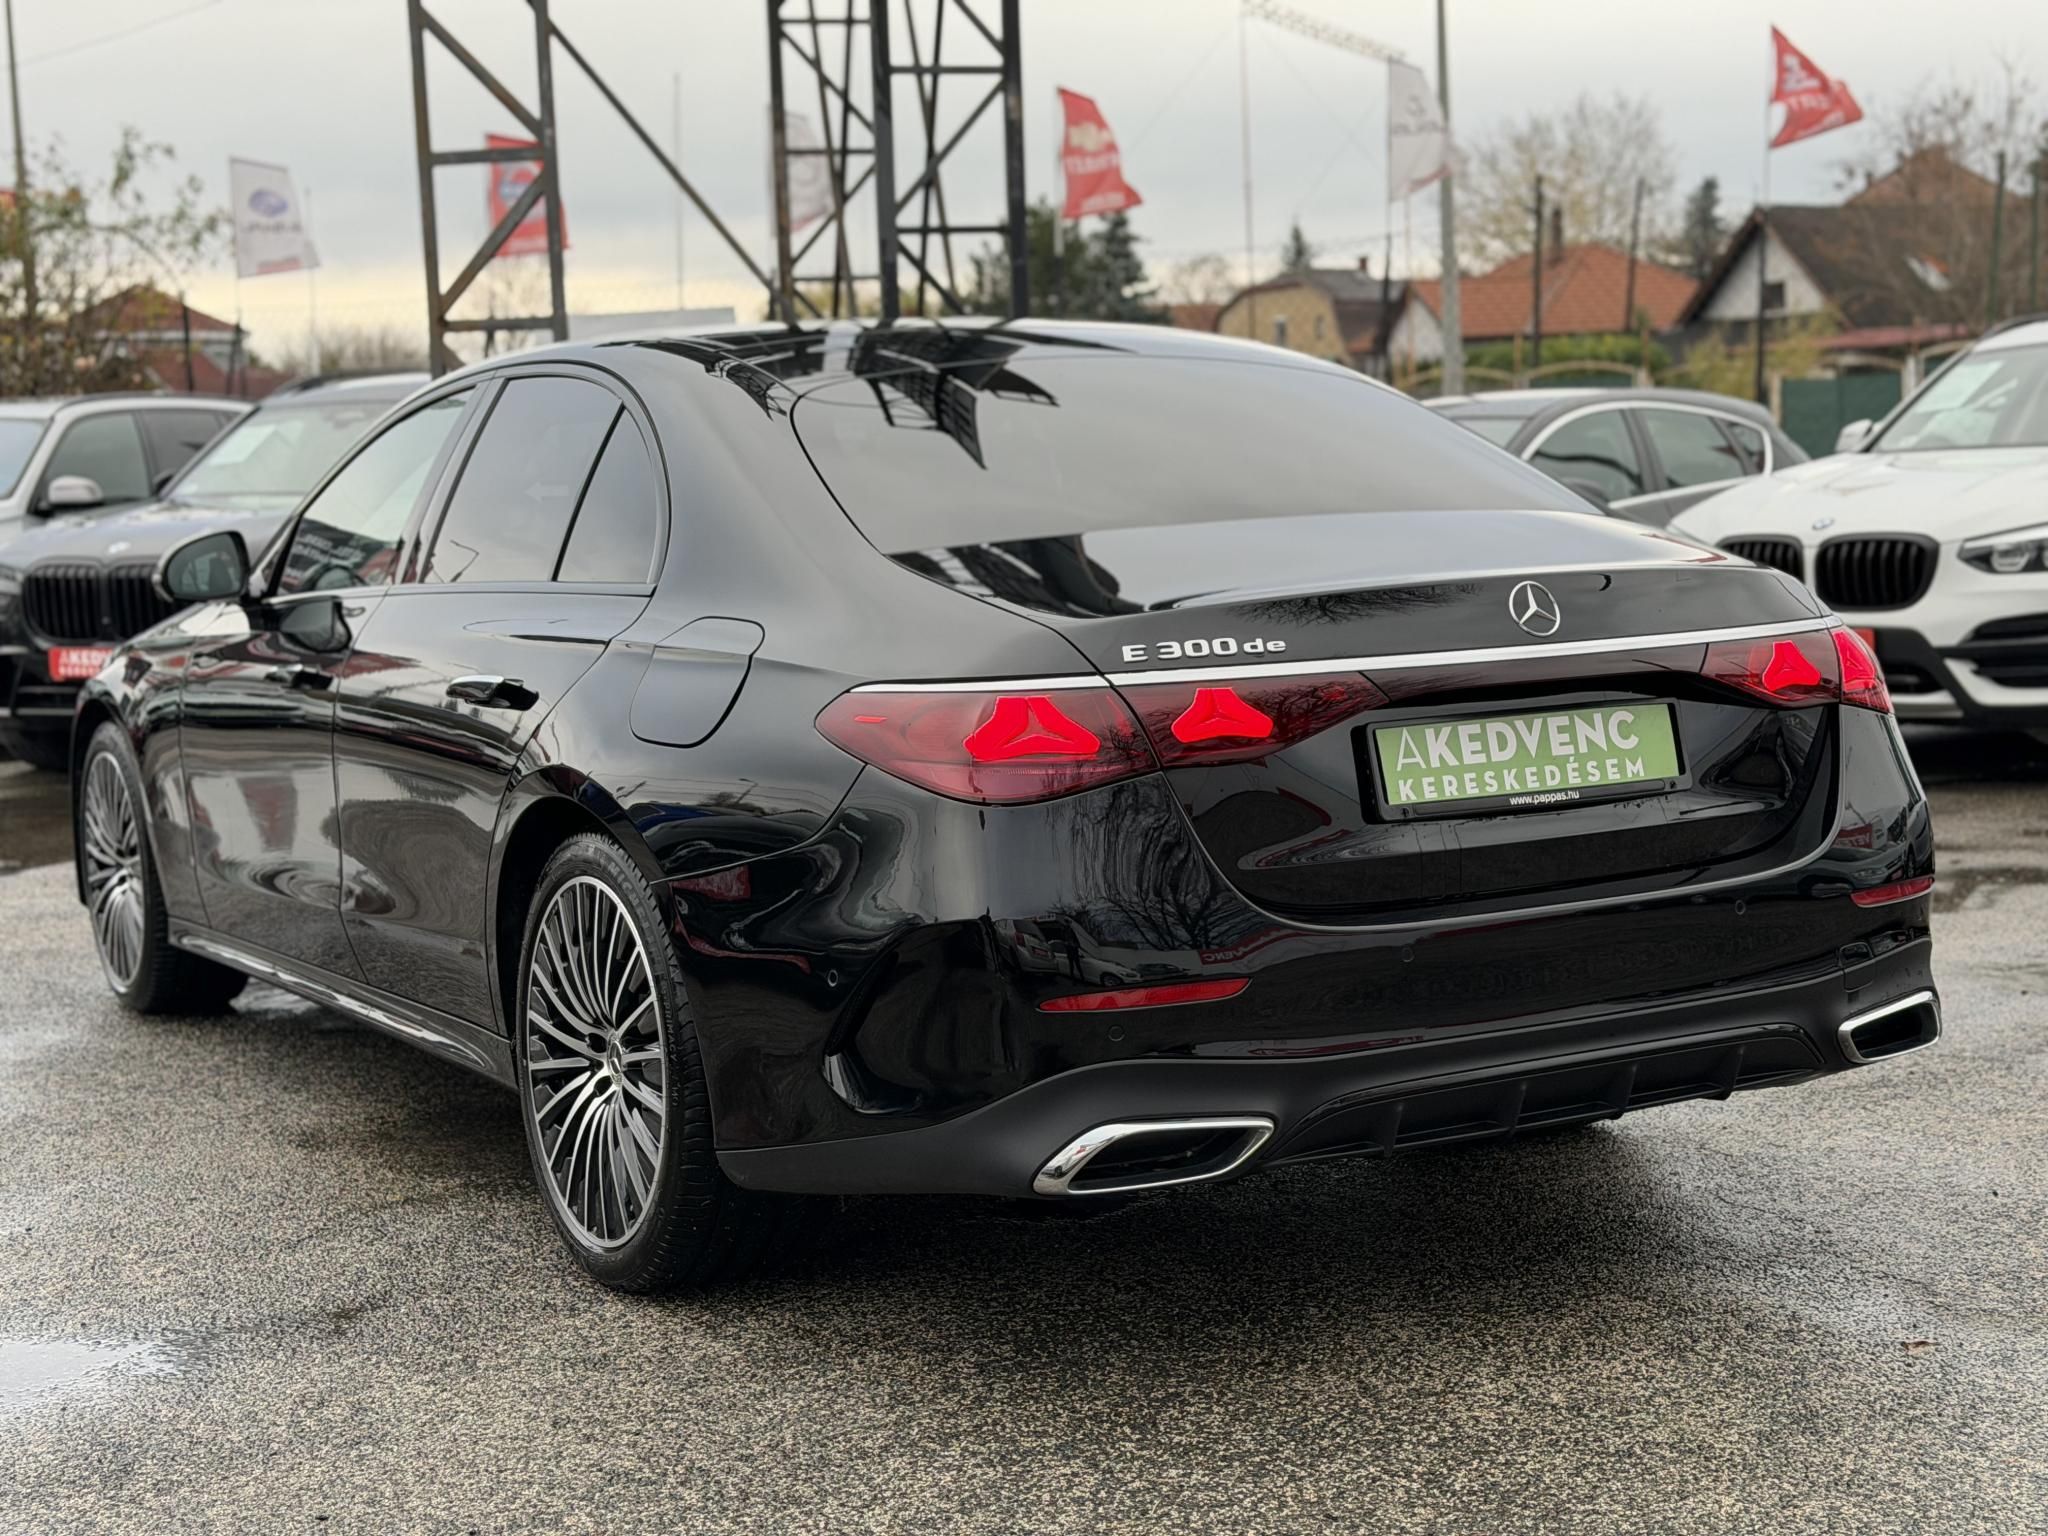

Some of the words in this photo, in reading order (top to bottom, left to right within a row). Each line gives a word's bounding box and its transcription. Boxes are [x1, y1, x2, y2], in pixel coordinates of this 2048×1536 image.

[1122, 644, 1149, 662] E
[1156, 637, 1238, 660] 300
[1243, 638, 1287, 654] de
[1398, 756, 1645, 801] KERESKEDÉSEM
[1509, 790, 1580, 805] www.pappas.hu
